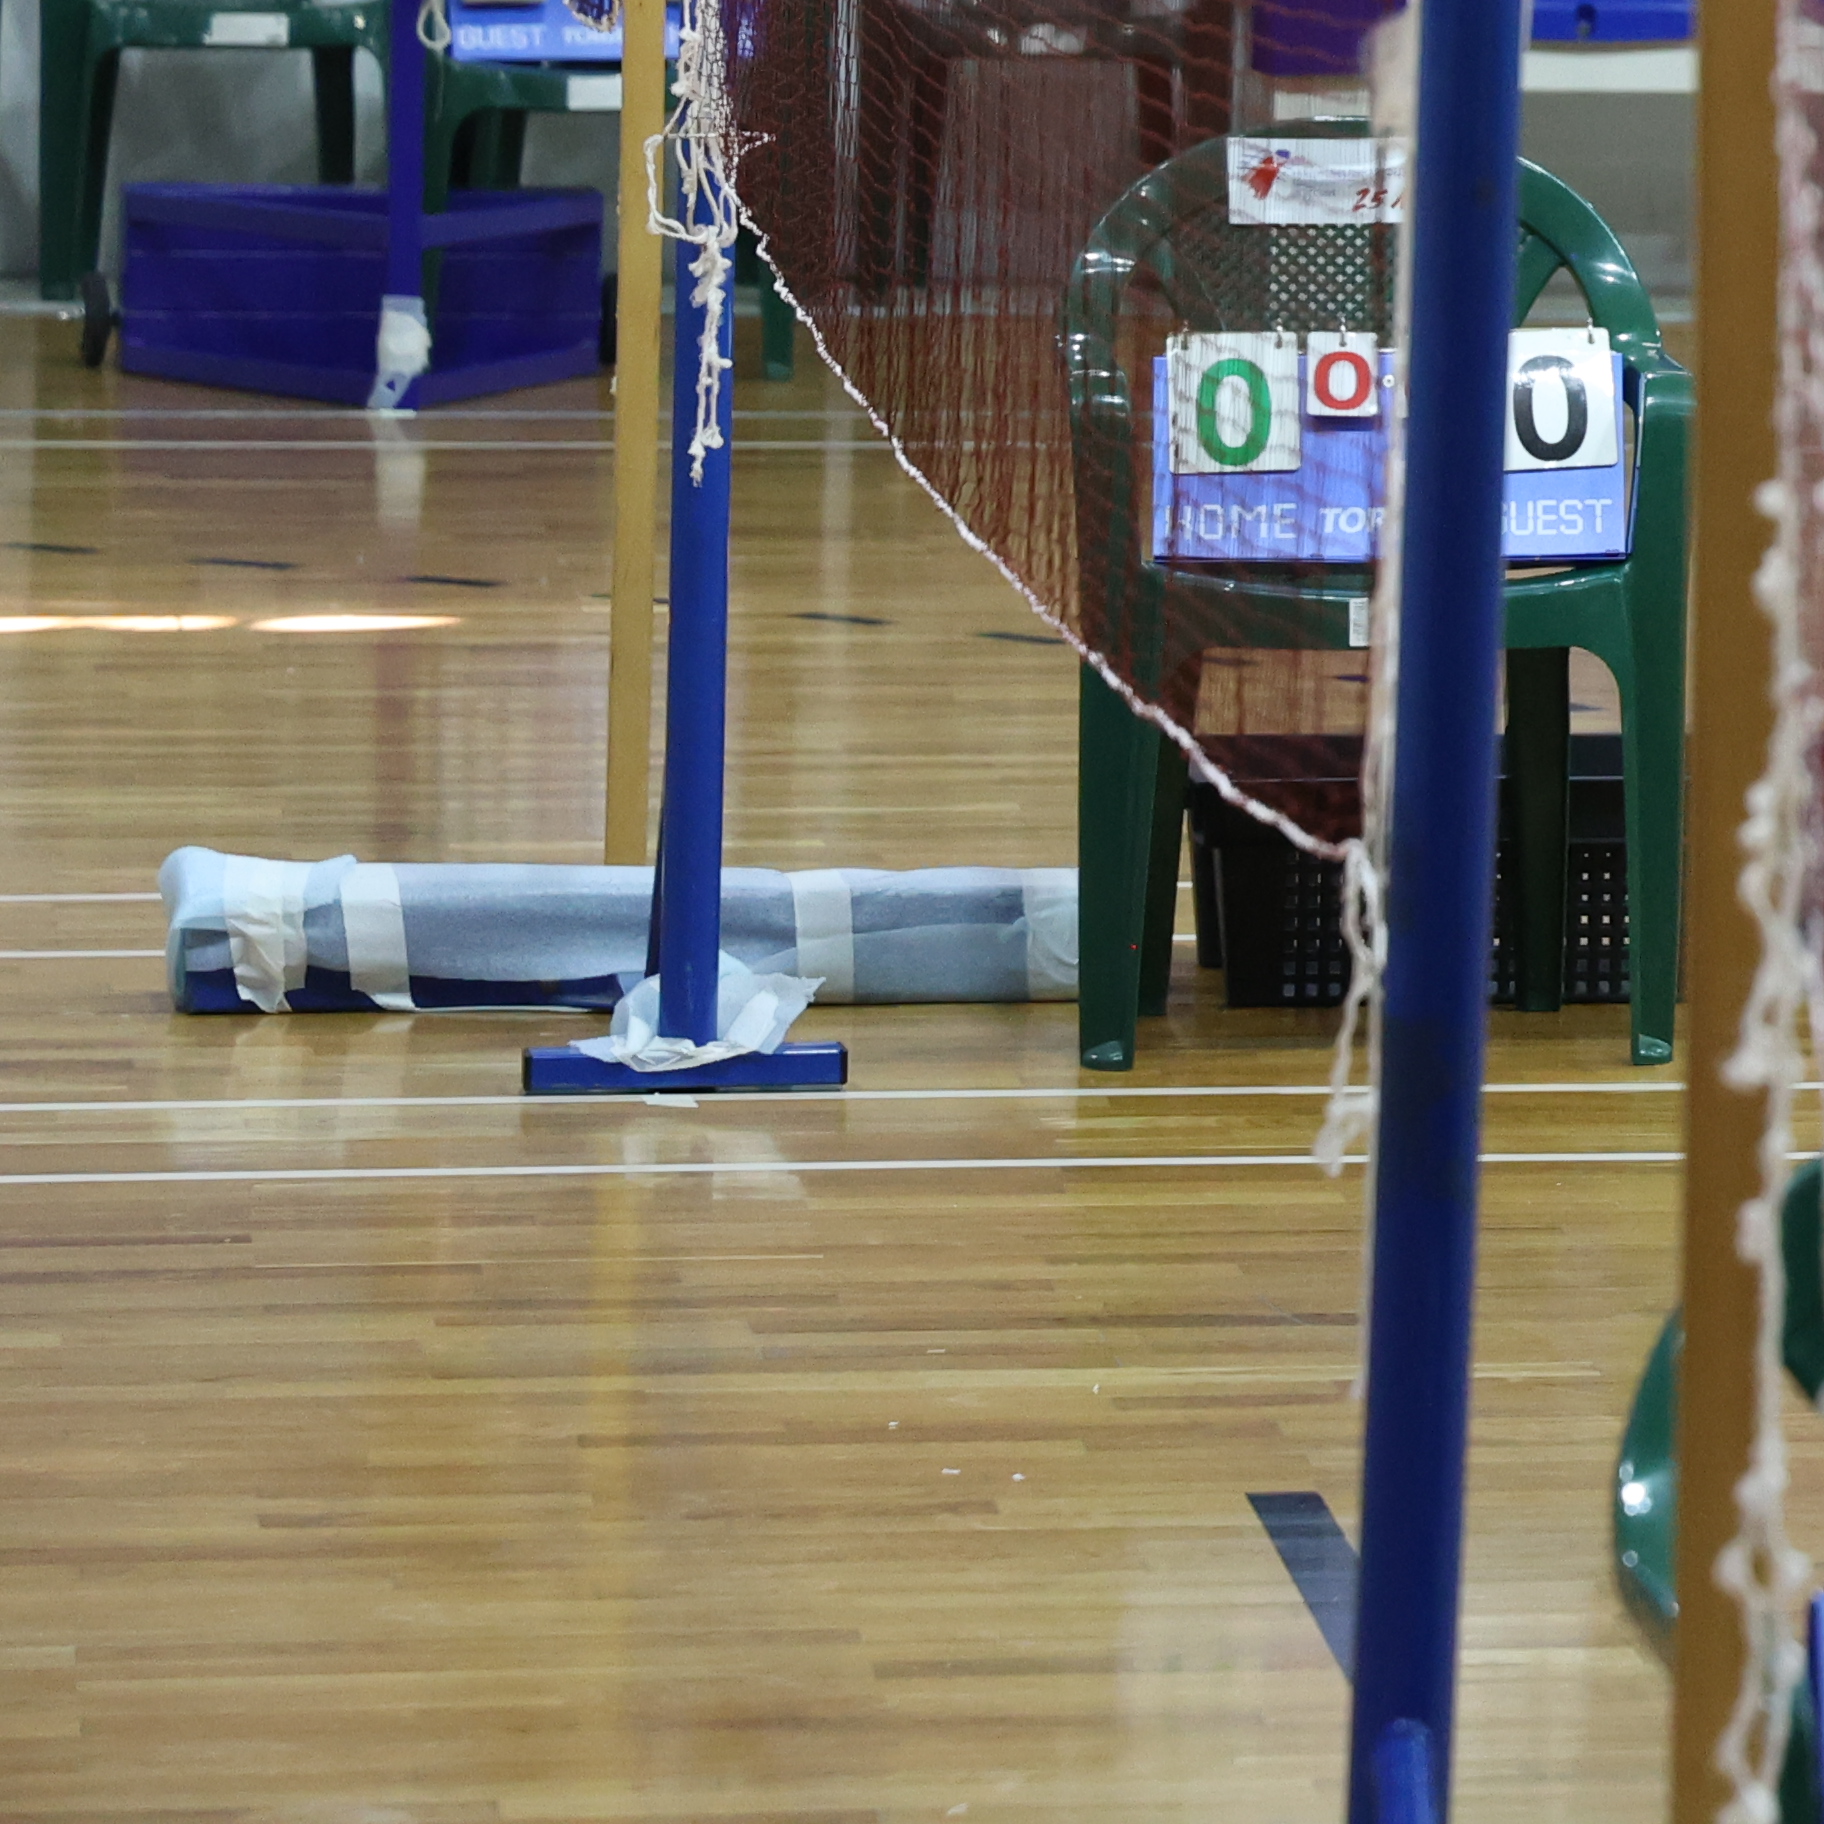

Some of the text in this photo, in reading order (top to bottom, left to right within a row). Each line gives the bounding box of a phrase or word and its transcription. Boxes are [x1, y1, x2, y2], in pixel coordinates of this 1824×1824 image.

[1197, 351, 1588, 466] 0 0 0
[1165, 502, 1298, 540] HOME
